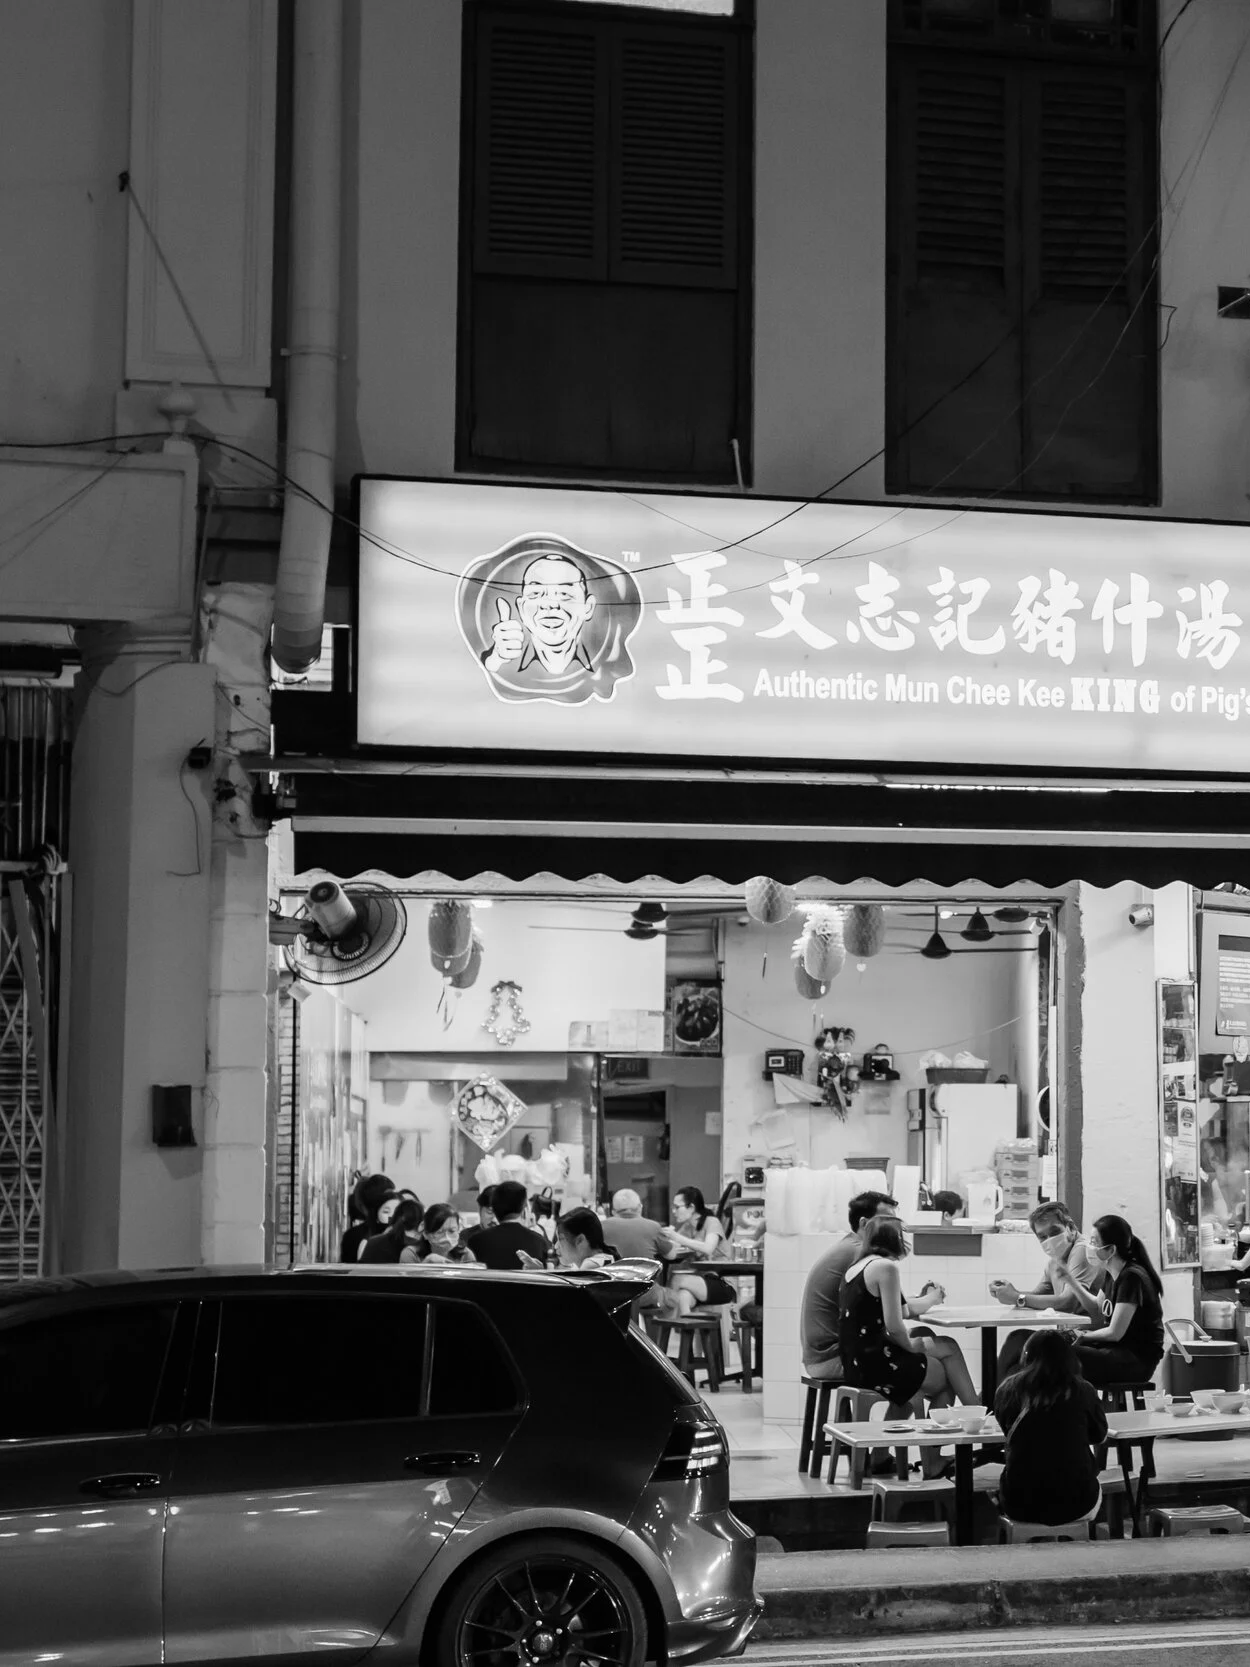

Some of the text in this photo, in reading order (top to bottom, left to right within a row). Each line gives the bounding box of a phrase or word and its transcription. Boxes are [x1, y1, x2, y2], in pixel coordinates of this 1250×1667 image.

[621, 550, 640, 563] TM
[753, 667, 879, 701] Authentic
[885, 673, 939, 703] Mun
[946, 675, 1010, 707] Chee
[1017, 678, 1066, 709] Kee
[1070, 677, 1160, 714] KING
[1170, 684, 1197, 713] of
[747, 1209, 766, 1219] POL
